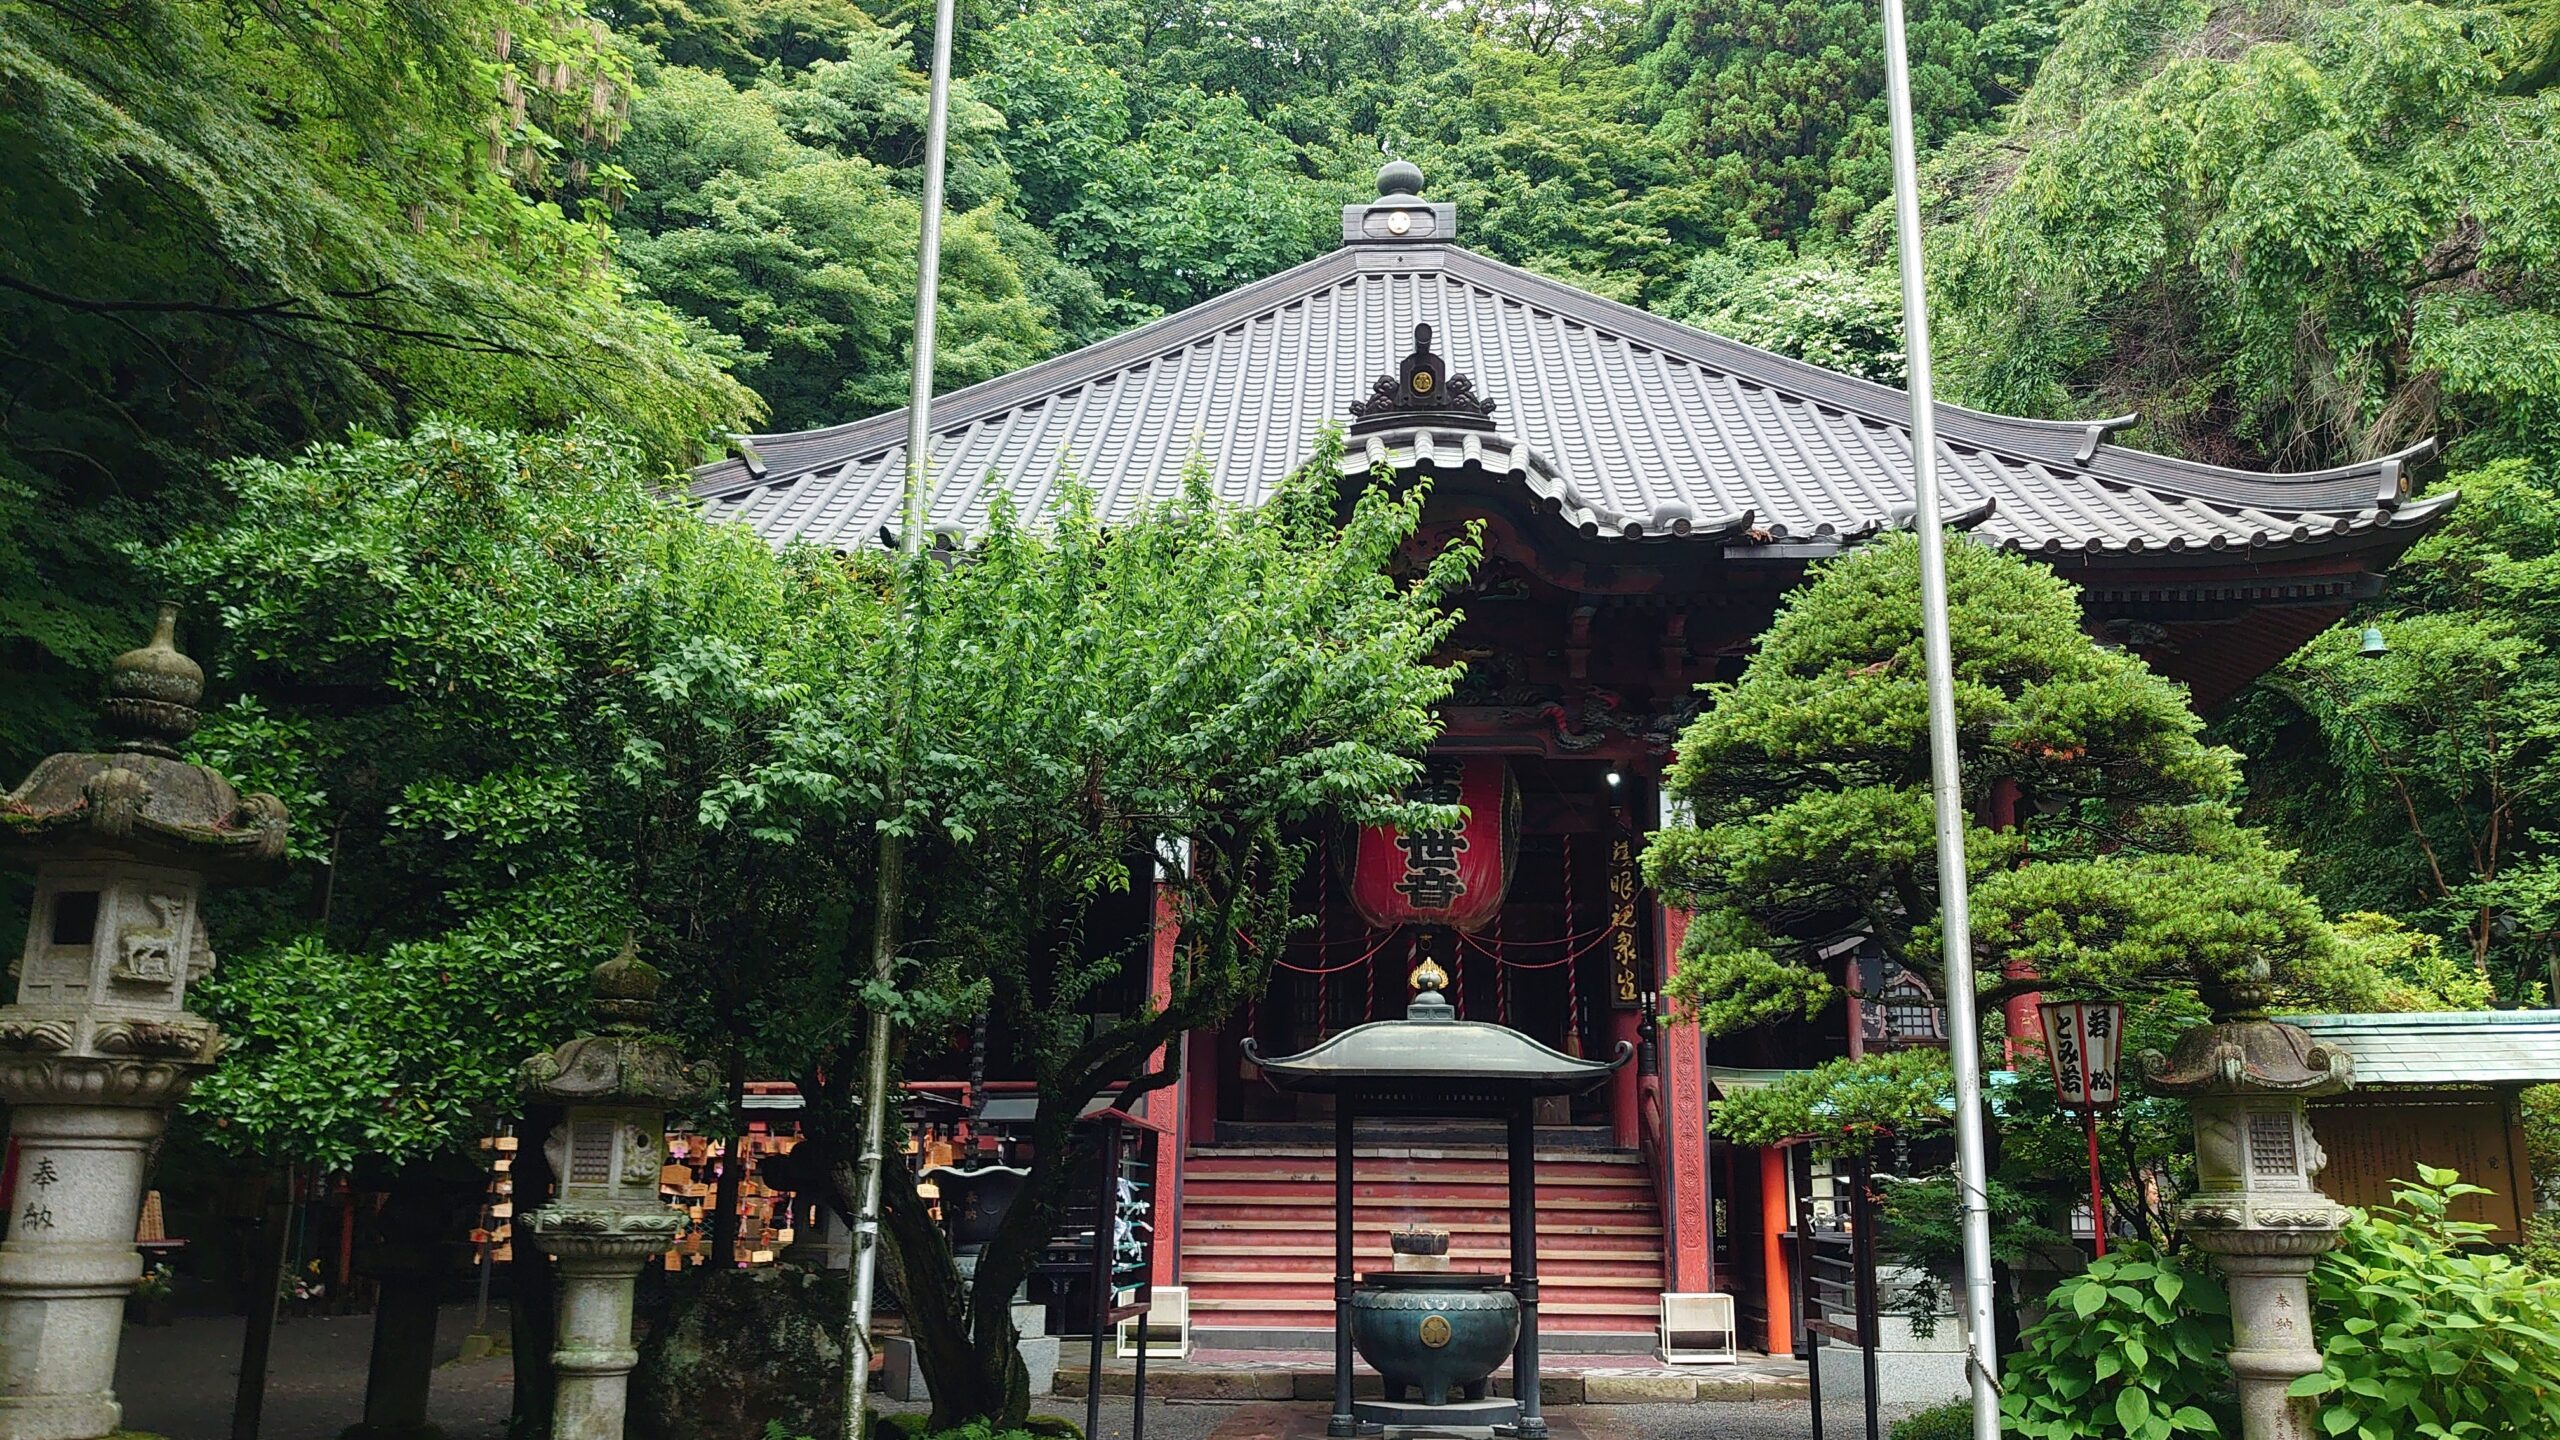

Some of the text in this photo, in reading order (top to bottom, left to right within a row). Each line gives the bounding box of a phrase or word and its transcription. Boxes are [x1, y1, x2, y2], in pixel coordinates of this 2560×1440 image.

[2055, 1012, 2082, 1094] とみ若
[2087, 1009, 2113, 1092] 若松
[2275, 1293, 2293, 1331] 奉納
